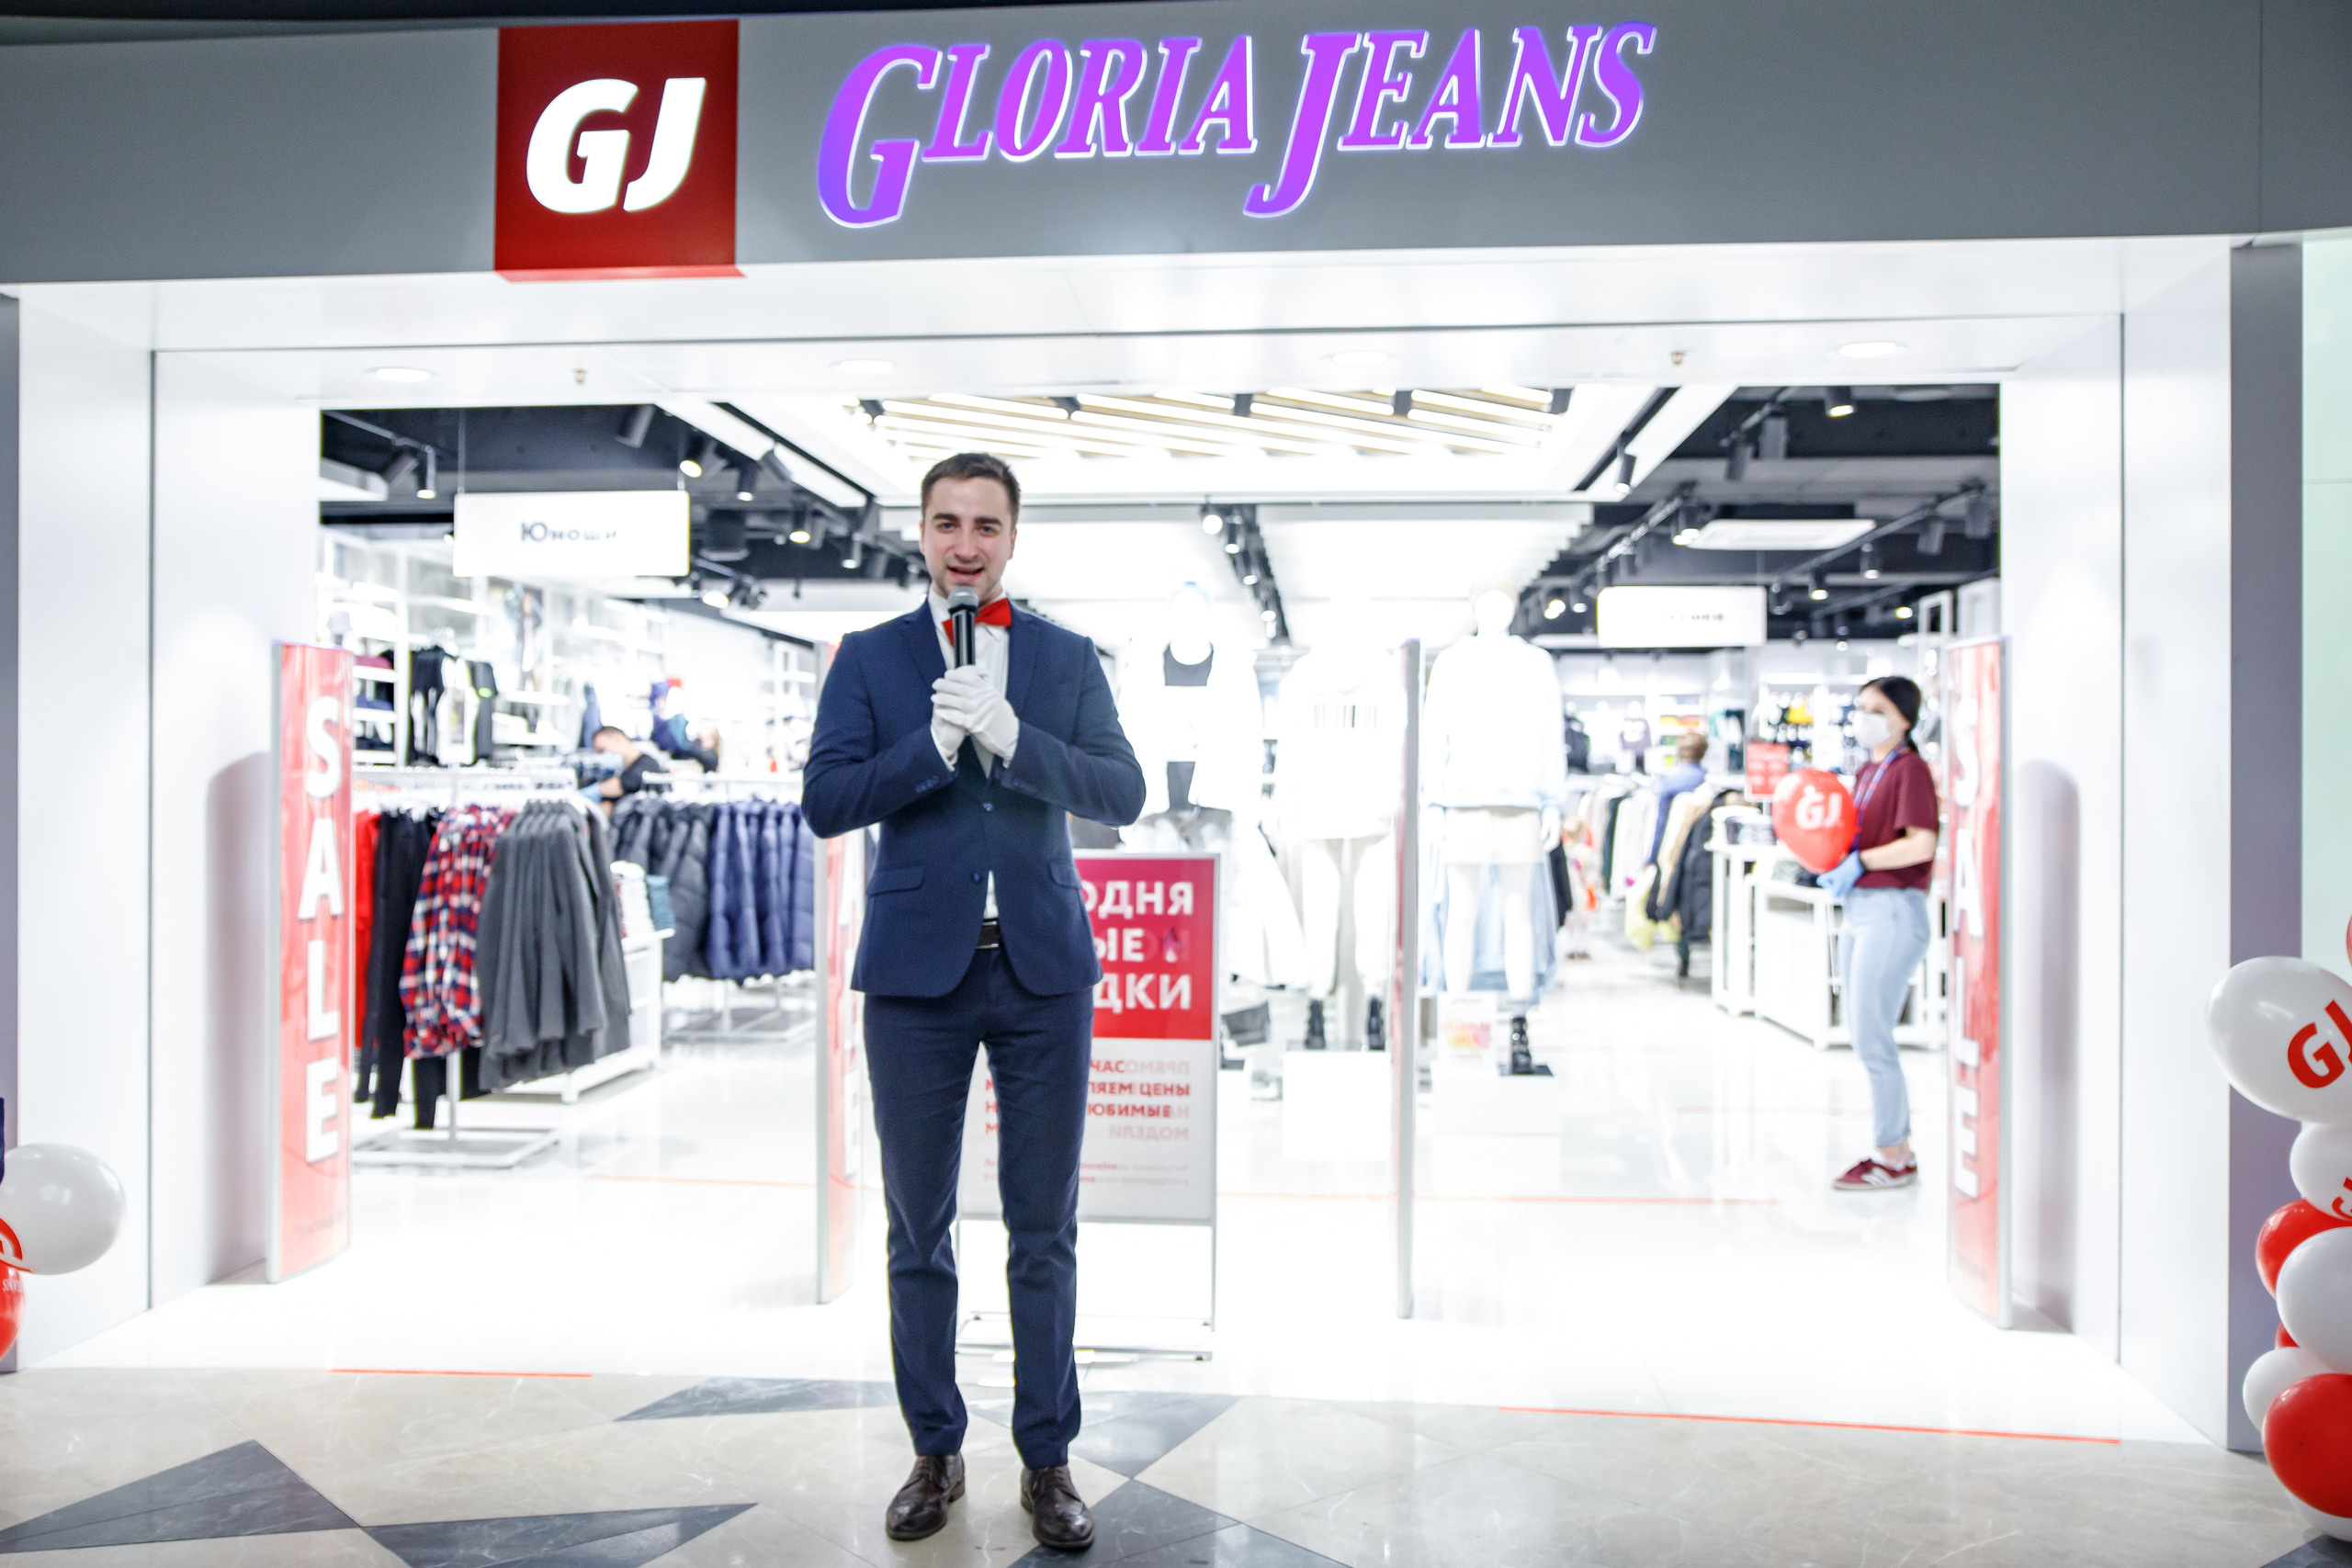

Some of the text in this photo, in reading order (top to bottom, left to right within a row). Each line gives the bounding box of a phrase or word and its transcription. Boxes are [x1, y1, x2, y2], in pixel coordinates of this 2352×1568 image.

[526, 77, 706, 213] GJ
[817, 21, 1657, 229] GLORIA JEANS
[1794, 791, 1843, 830] GJ
[298, 694, 344, 1165] SALE
[1093, 973, 1192, 1014] ДКИ
[1140, 1083, 1190, 1097] ЦЕНЫ
